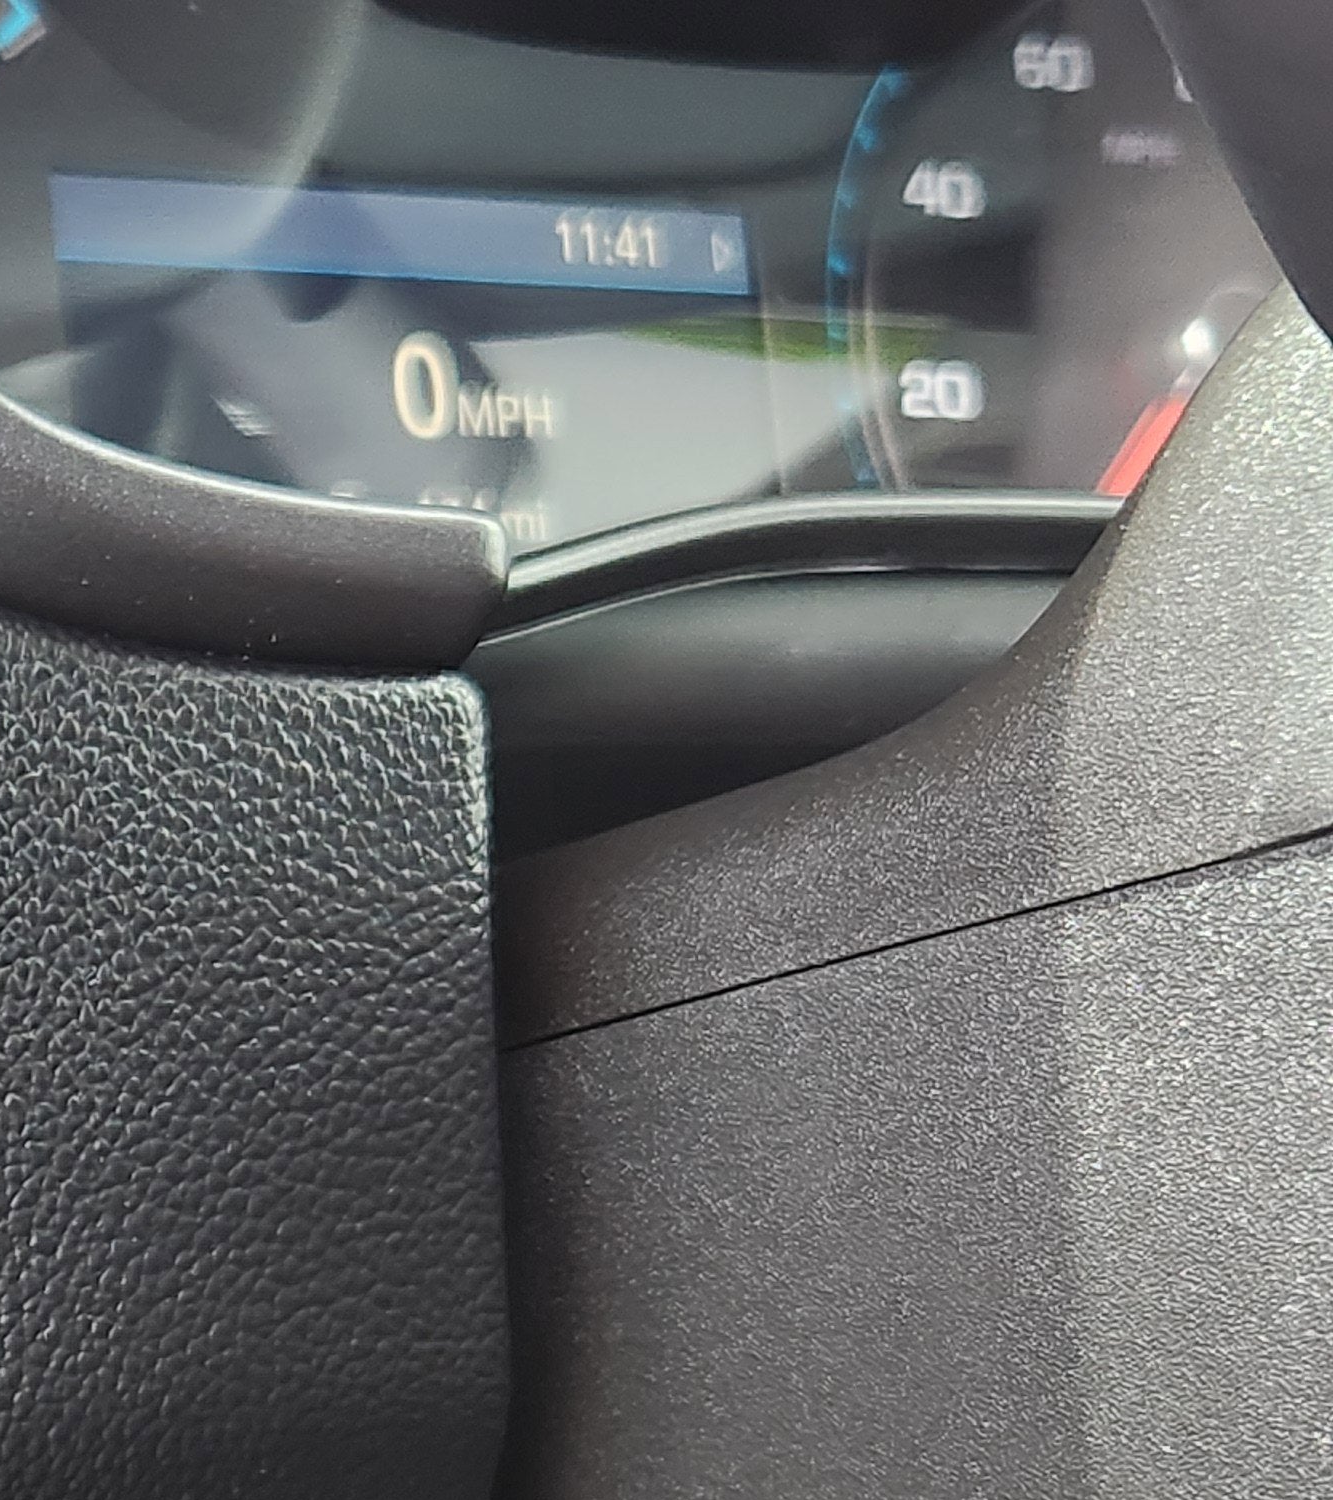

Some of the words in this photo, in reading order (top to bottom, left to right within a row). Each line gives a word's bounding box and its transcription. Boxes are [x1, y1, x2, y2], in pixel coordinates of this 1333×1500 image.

[902, 159, 985, 218] 40
[555, 216, 663, 268] 11:41
[393, 330, 457, 440] 0
[457, 389, 554, 438] MPH
[900, 359, 985, 420] 20
